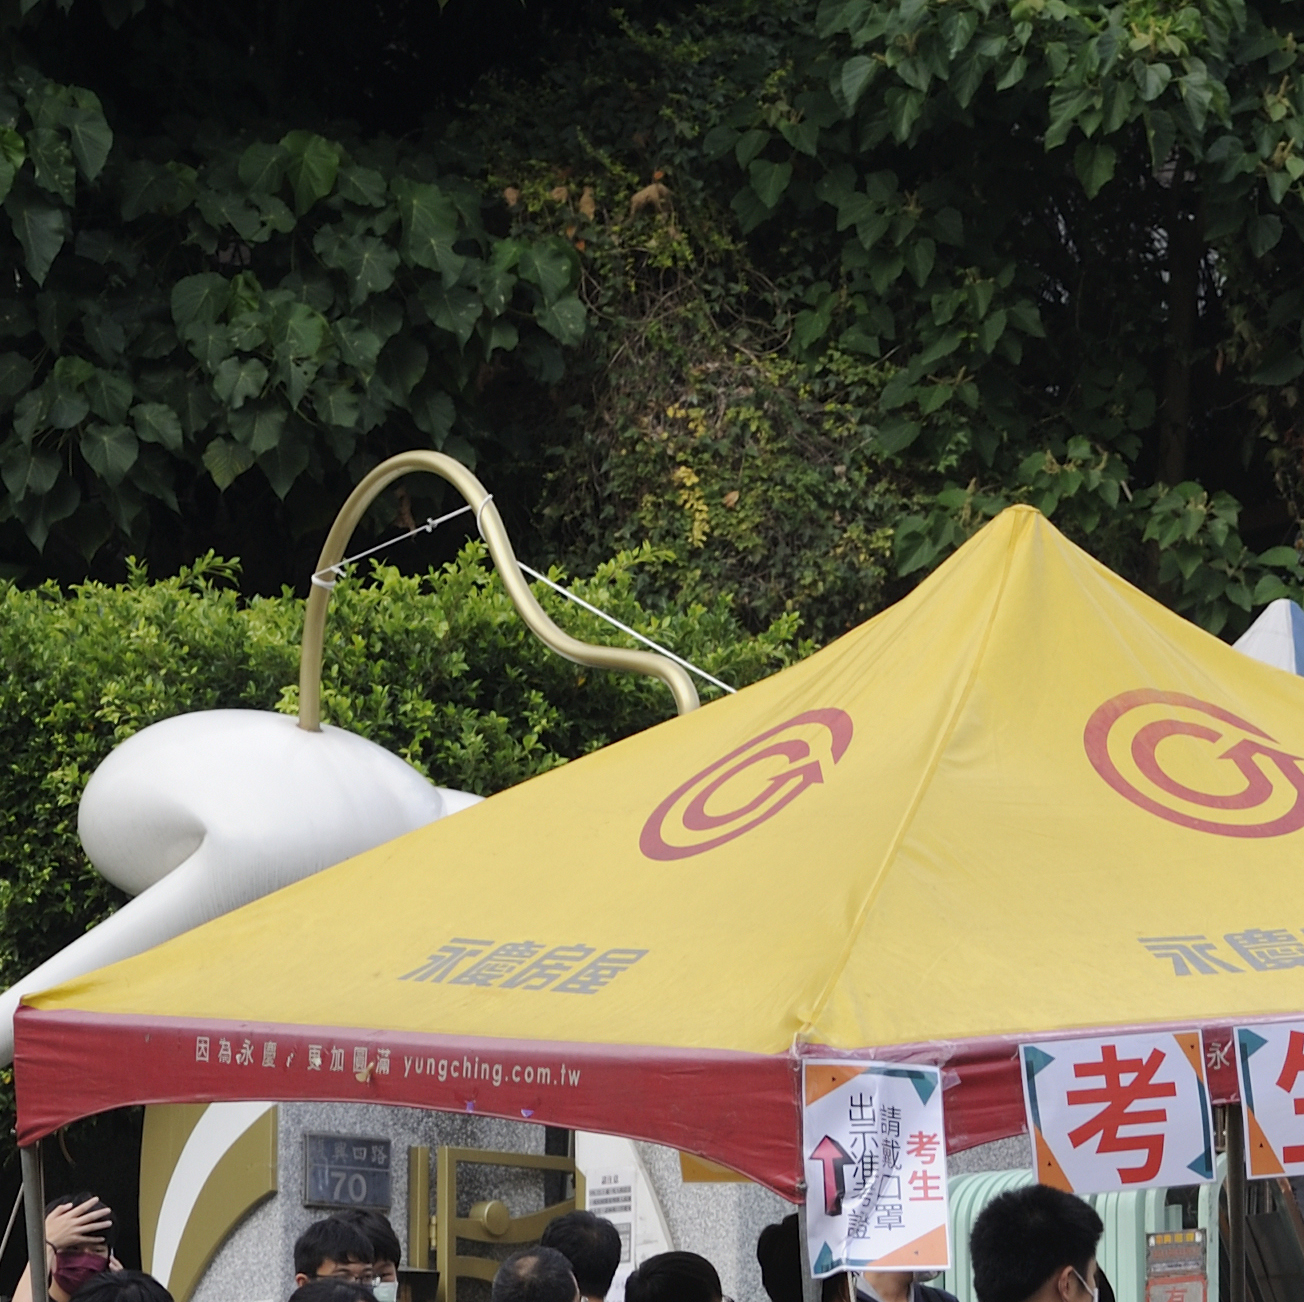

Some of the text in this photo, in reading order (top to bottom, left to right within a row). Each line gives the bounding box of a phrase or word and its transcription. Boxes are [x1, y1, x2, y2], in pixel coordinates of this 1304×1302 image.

[398, 937, 649, 996] 永慶房屋
[403, 1054, 581, 1087] yungching.com.tw
[331, 1170, 367, 1203] 70
[874, 1104, 905, 1231] 請戴口罩
[906, 1130, 944, 1203] 考生
